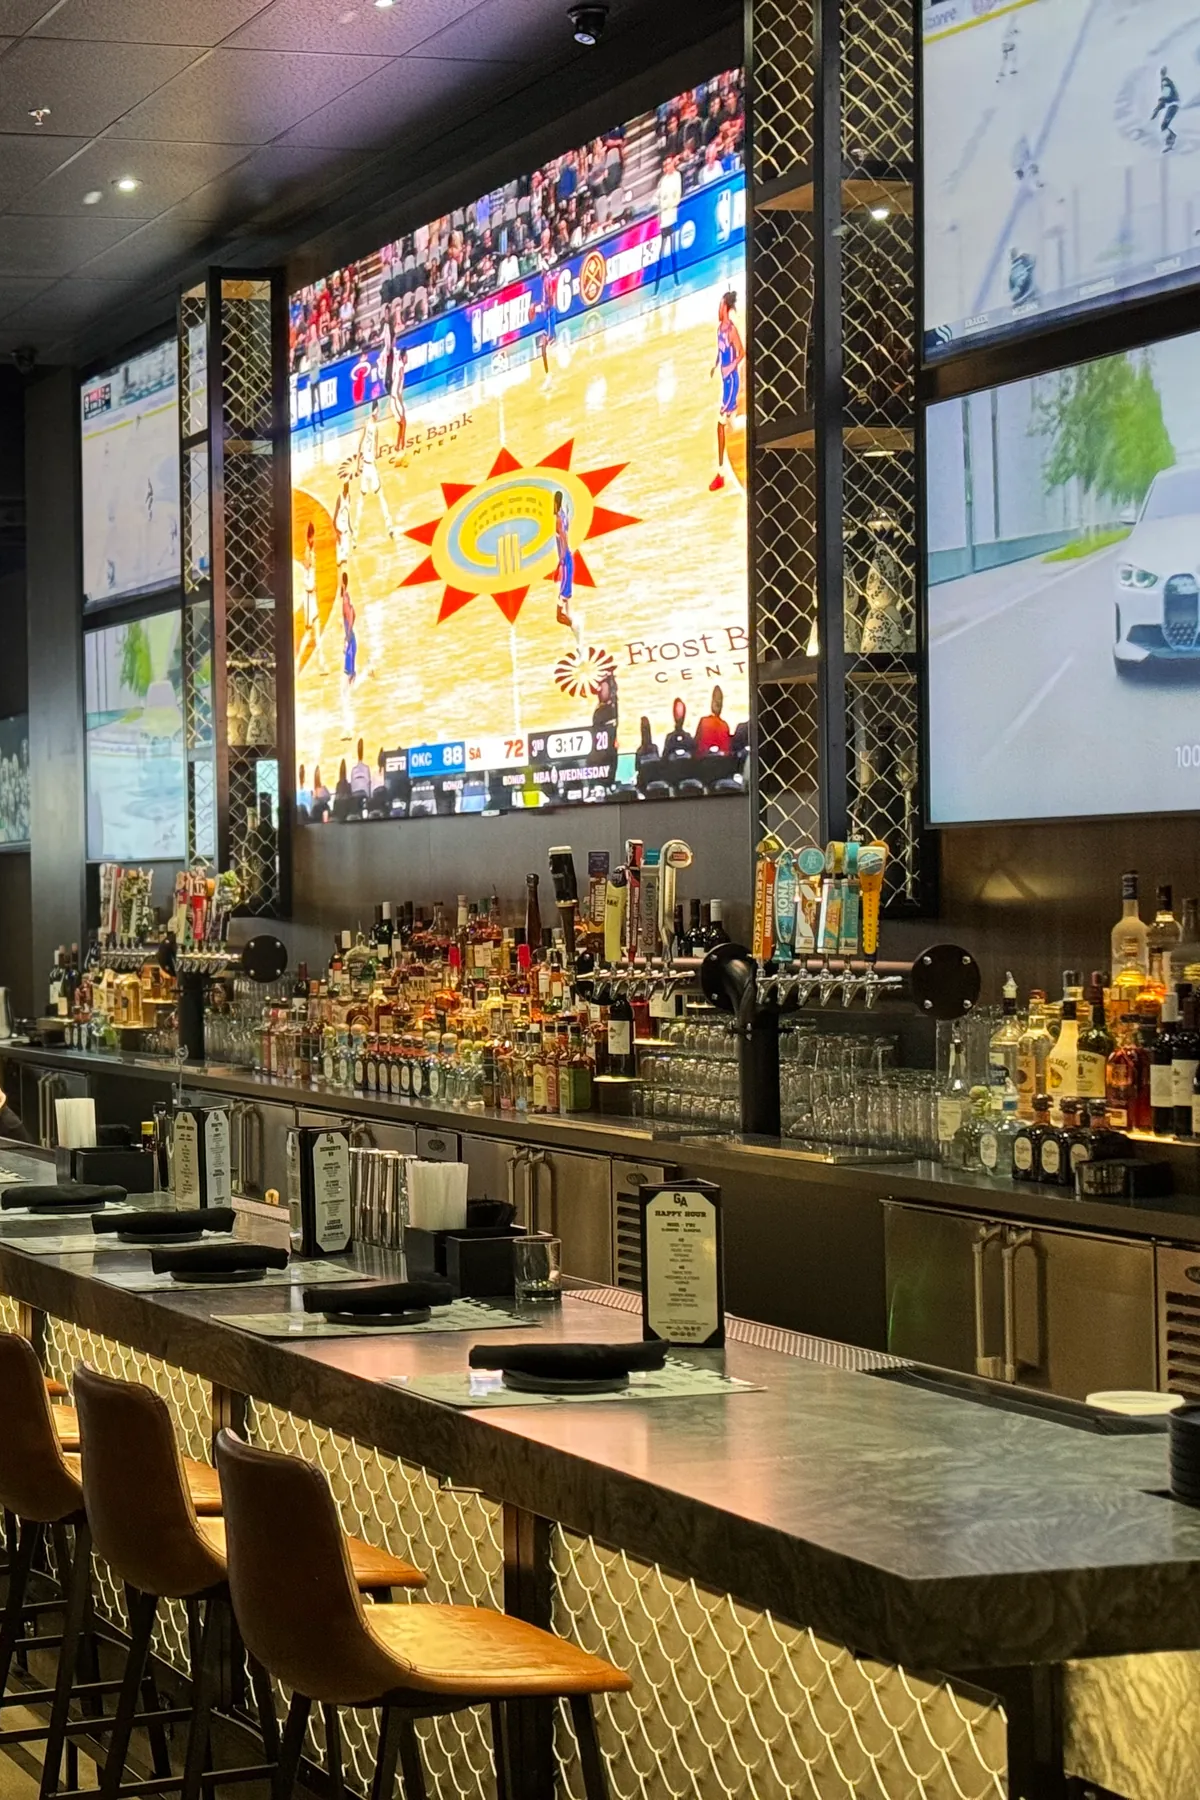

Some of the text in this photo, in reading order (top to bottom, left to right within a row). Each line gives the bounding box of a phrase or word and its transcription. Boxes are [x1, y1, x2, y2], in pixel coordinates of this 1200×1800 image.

[426, 413, 472, 440] Bank
[388, 435, 457, 465] CNTER
[624, 634, 717, 666] Frost
[655, 661, 746, 683] CENT
[411, 752, 432, 767] OKC
[443, 745, 463, 766] 88
[469, 747, 481, 760] SA
[504, 739, 523, 759] 72
[555, 736, 583, 753] 3:17
[596, 731, 608, 750] 20
[1175, 745, 1200, 767] 100
[533, 766, 610, 783] NBA WEDNESDAY
[595, 884, 606, 922] BONANZA
[777, 880, 789, 916] KONA
[643, 889, 654, 946] Coors LIGHT
[674, 1193, 688, 1207] GA
